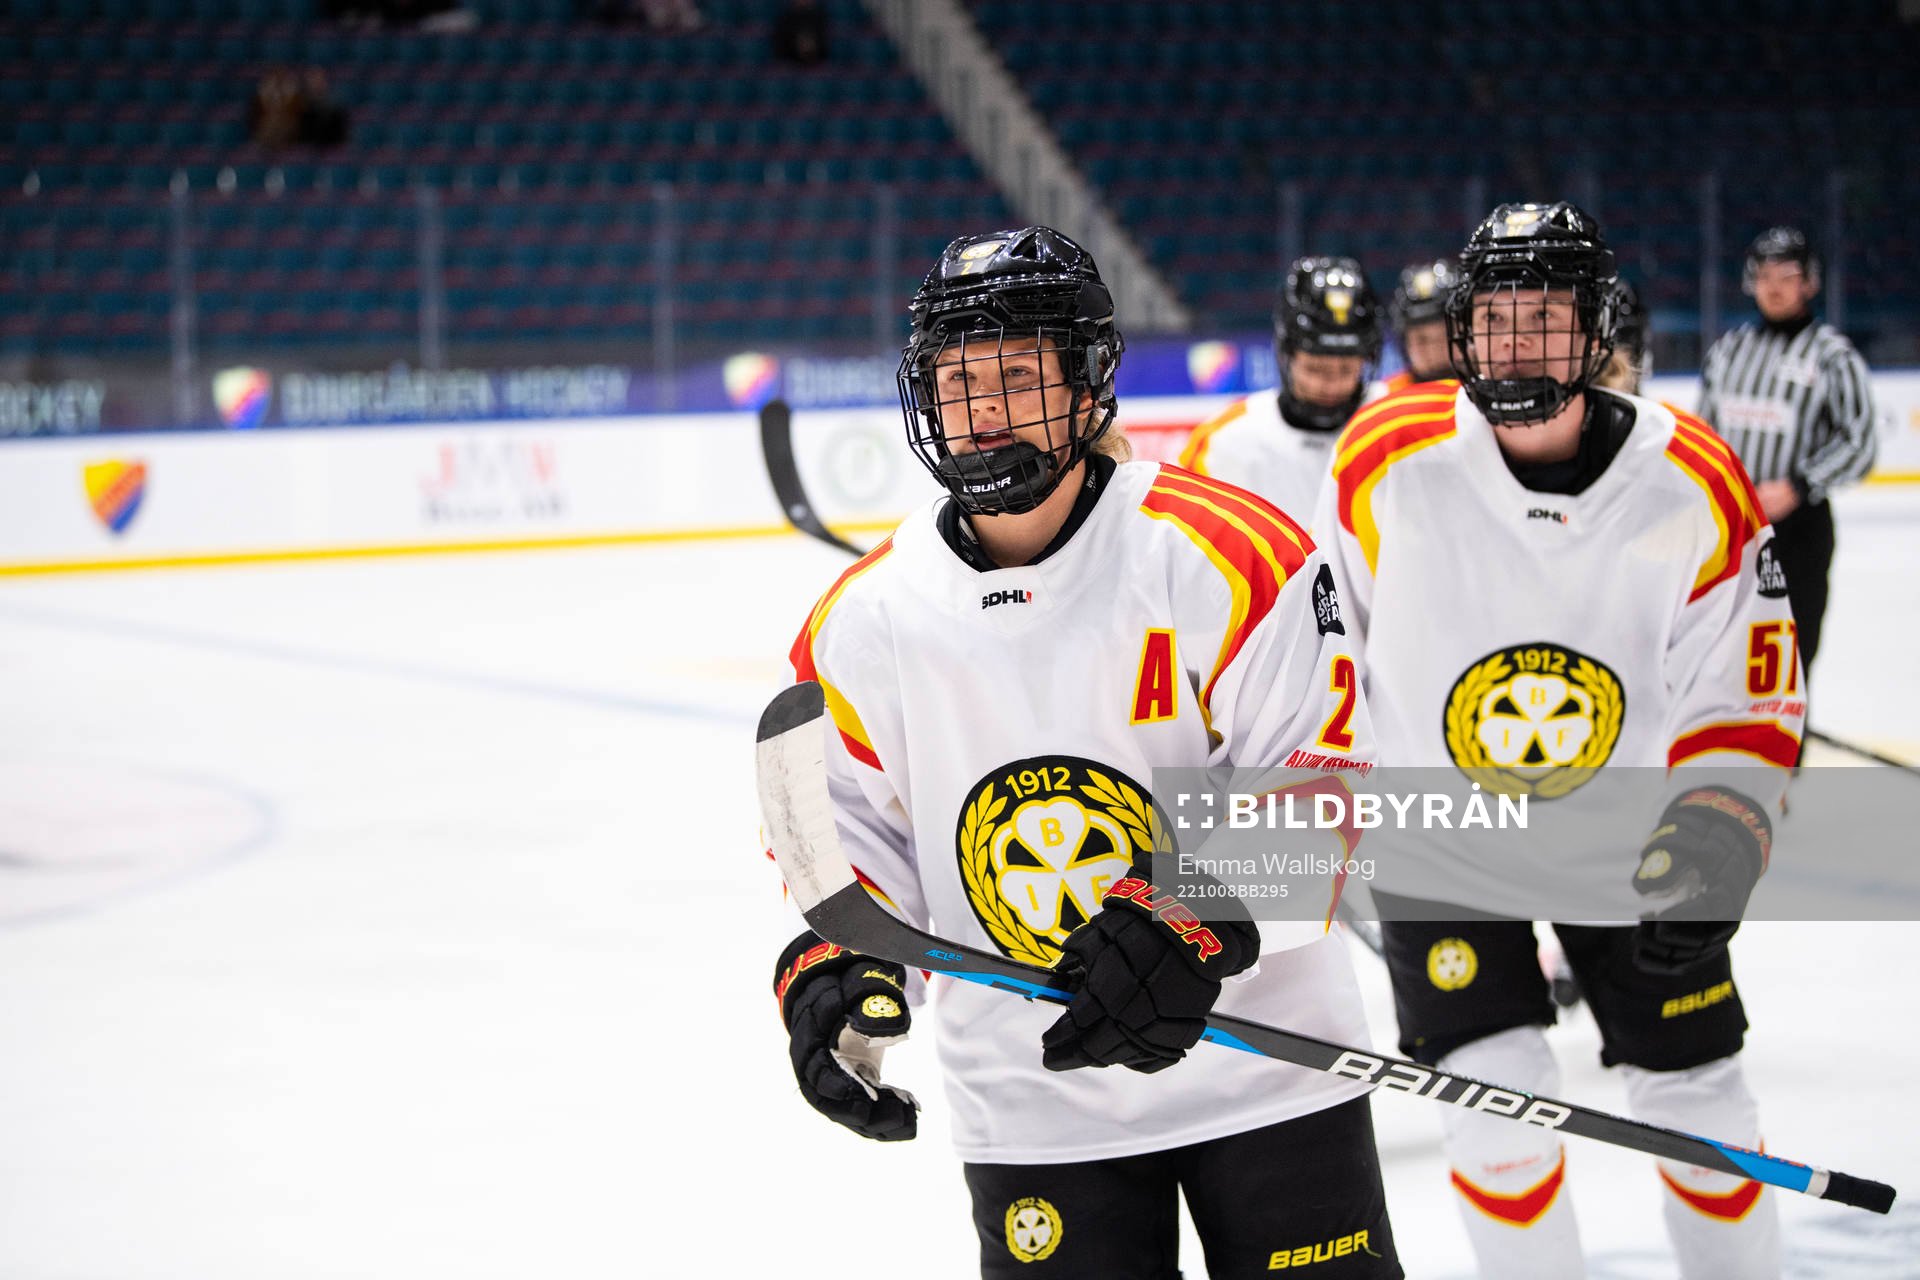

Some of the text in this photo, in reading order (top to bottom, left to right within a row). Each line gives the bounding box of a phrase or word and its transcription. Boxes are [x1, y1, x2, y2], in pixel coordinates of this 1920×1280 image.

[961, 261, 974, 276] 2
[1129, 627, 1178, 726] A
[1513, 649, 1567, 673] 1912
[1316, 655, 1357, 753] 2
[1530, 687, 1546, 705] B
[1006, 766, 1071, 799] 1912
[1040, 817, 1065, 848] B
[1103, 877, 1223, 963] AUER
[1327, 1051, 1573, 1129] BAUER
[1267, 1229, 1369, 1270] BAUER
